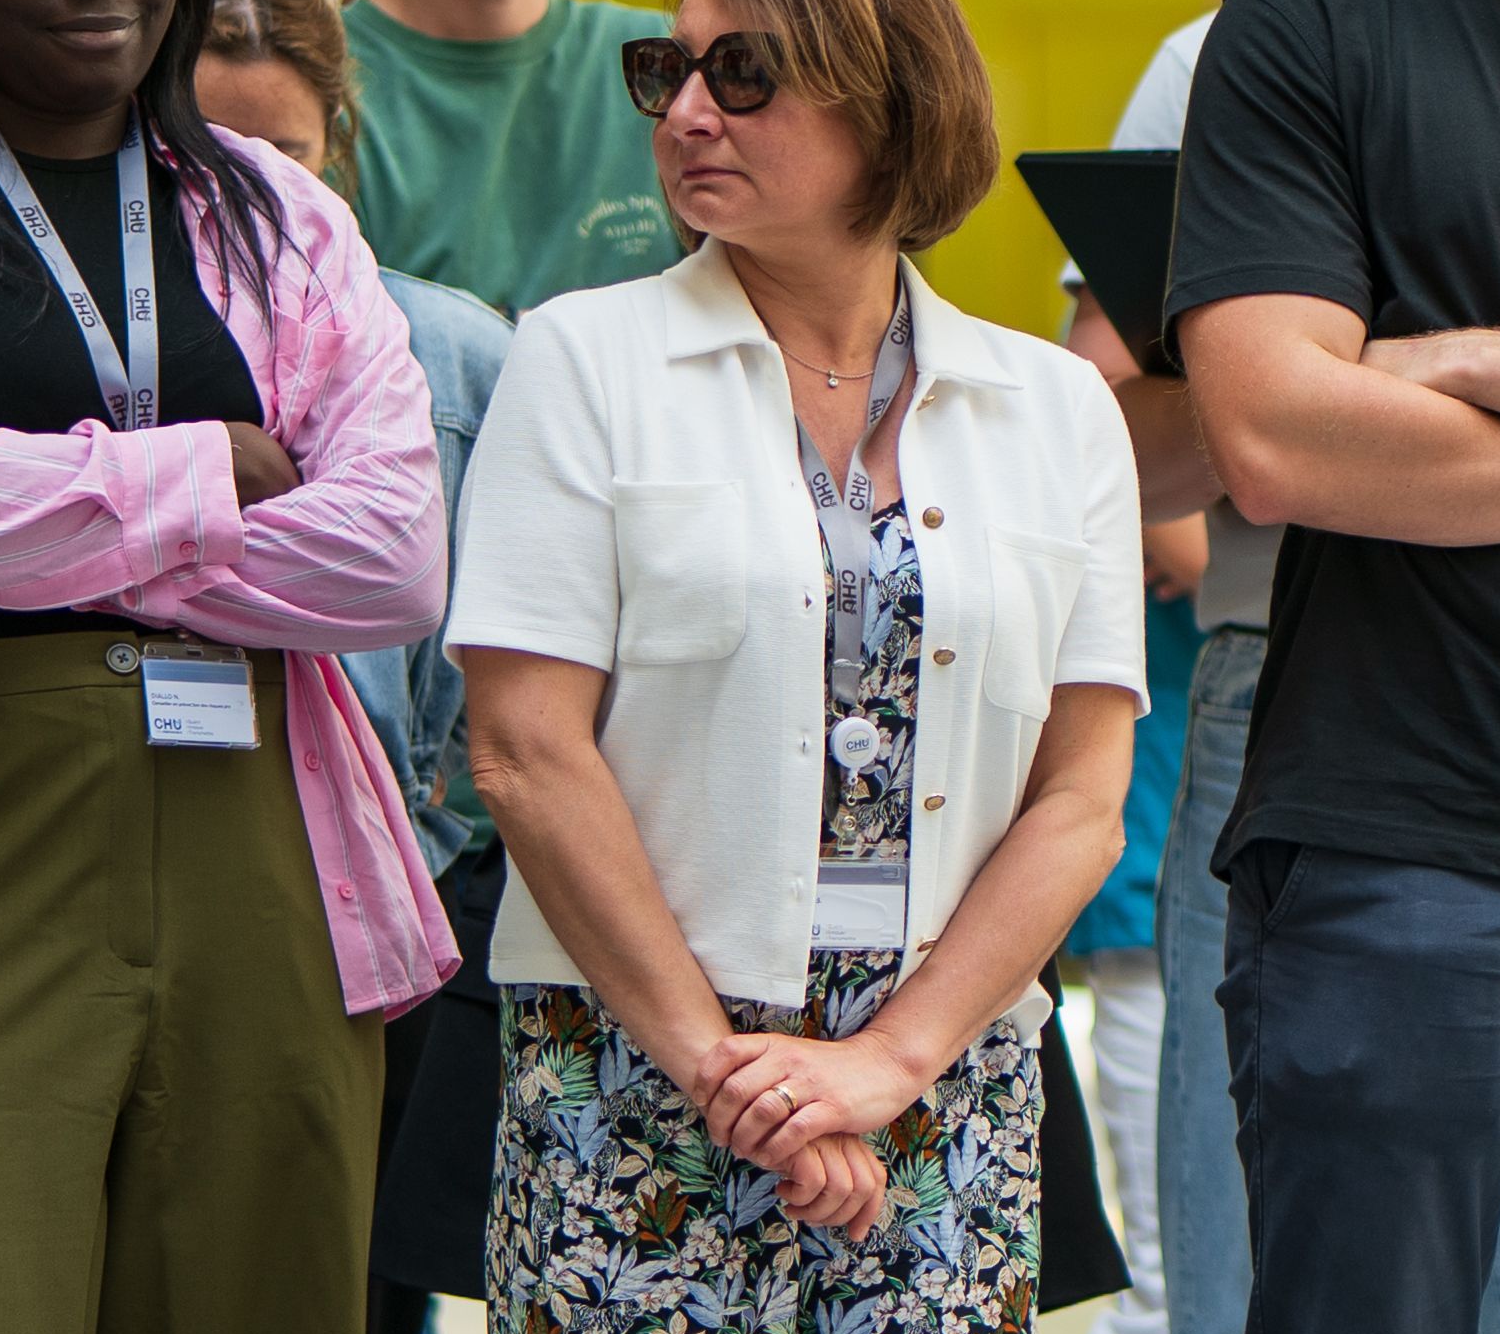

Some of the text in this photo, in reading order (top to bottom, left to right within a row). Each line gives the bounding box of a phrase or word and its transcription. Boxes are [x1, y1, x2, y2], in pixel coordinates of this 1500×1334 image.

[19, 207, 48, 239] CHU
[129, 200, 146, 234] CHU
[69, 292, 96, 328] CHU
[134, 287, 151, 321] CHU
[890, 308, 910, 346] CHU
[108, 395, 130, 431] HU
[869, 398, 885, 424] HU
[812, 471, 838, 510] CHU
[850, 472, 868, 512] CHU
[841, 570, 858, 616] CHU
[154, 718, 182, 730] CHU
[846, 738, 870, 750] CHU
